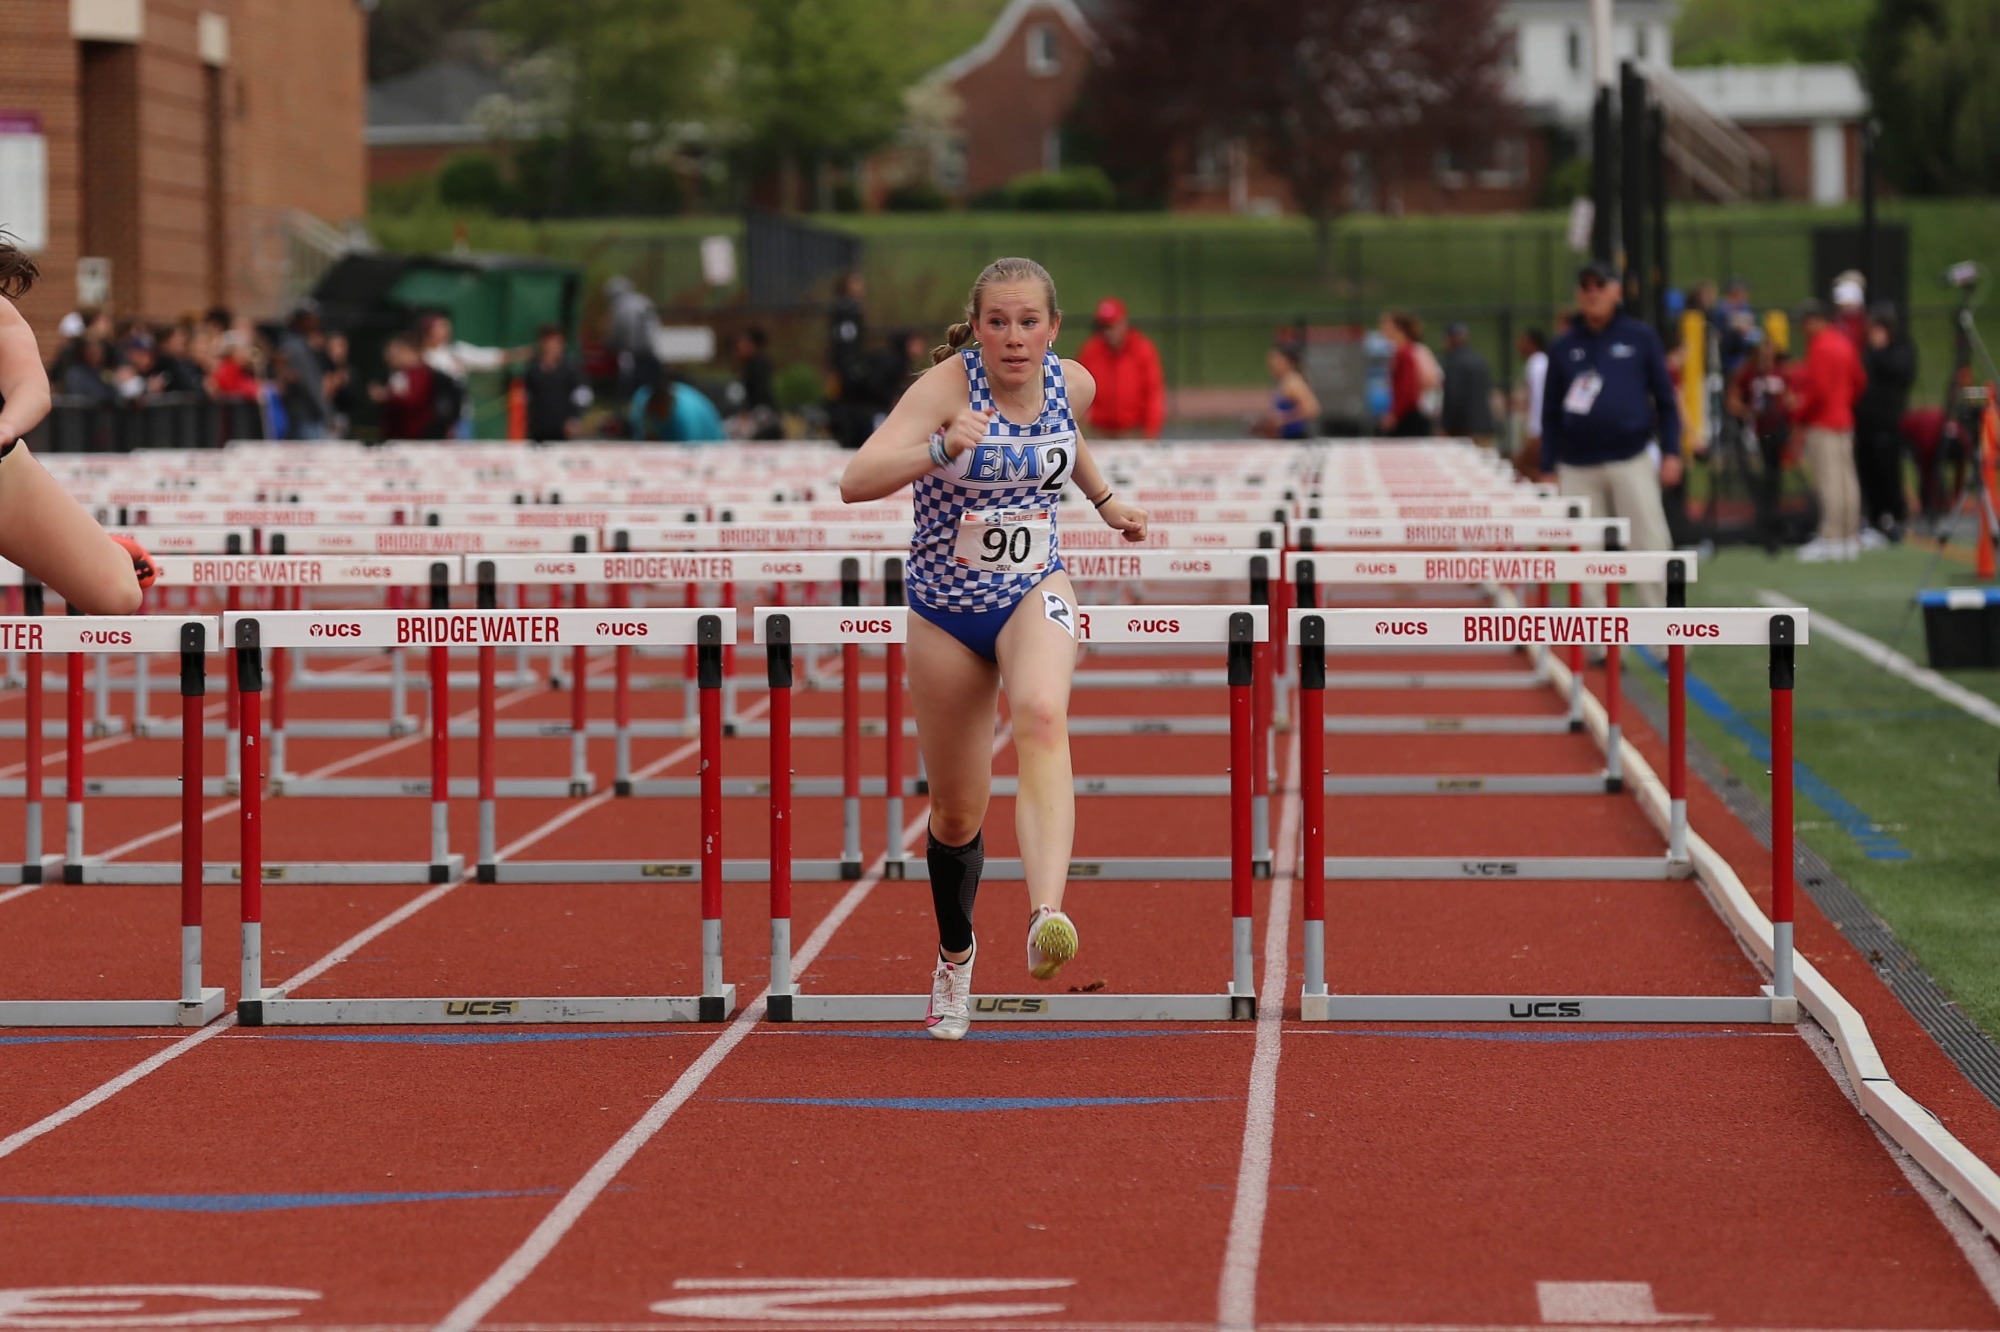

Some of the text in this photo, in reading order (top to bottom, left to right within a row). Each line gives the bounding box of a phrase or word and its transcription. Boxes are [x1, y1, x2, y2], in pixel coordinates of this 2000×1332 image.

[961, 443, 1044, 482] EM
[1041, 448, 1068, 491] 2
[980, 526, 1032, 564] 90
[193, 561, 322, 583] BRIDGEWATER
[604, 558, 733, 579] BRIDGEWATER
[1425, 559, 1555, 580] BRIDGEWATER
[1048, 594, 1070, 631] 2
[325, 615, 649, 646] UCS BRIDGEWATER UCS
[855, 619, 892, 633] UCS
[1143, 619, 1180, 633] UCS
[1391, 615, 1719, 643] UCS BRIDGEWATER UCS
[95, 631, 132, 645] UCS
[641, 865, 693, 877] UCS
[445, 1000, 512, 1015] UCS
[975, 998, 1042, 1013] UCS
[1509, 1002, 1581, 1019] UCS
